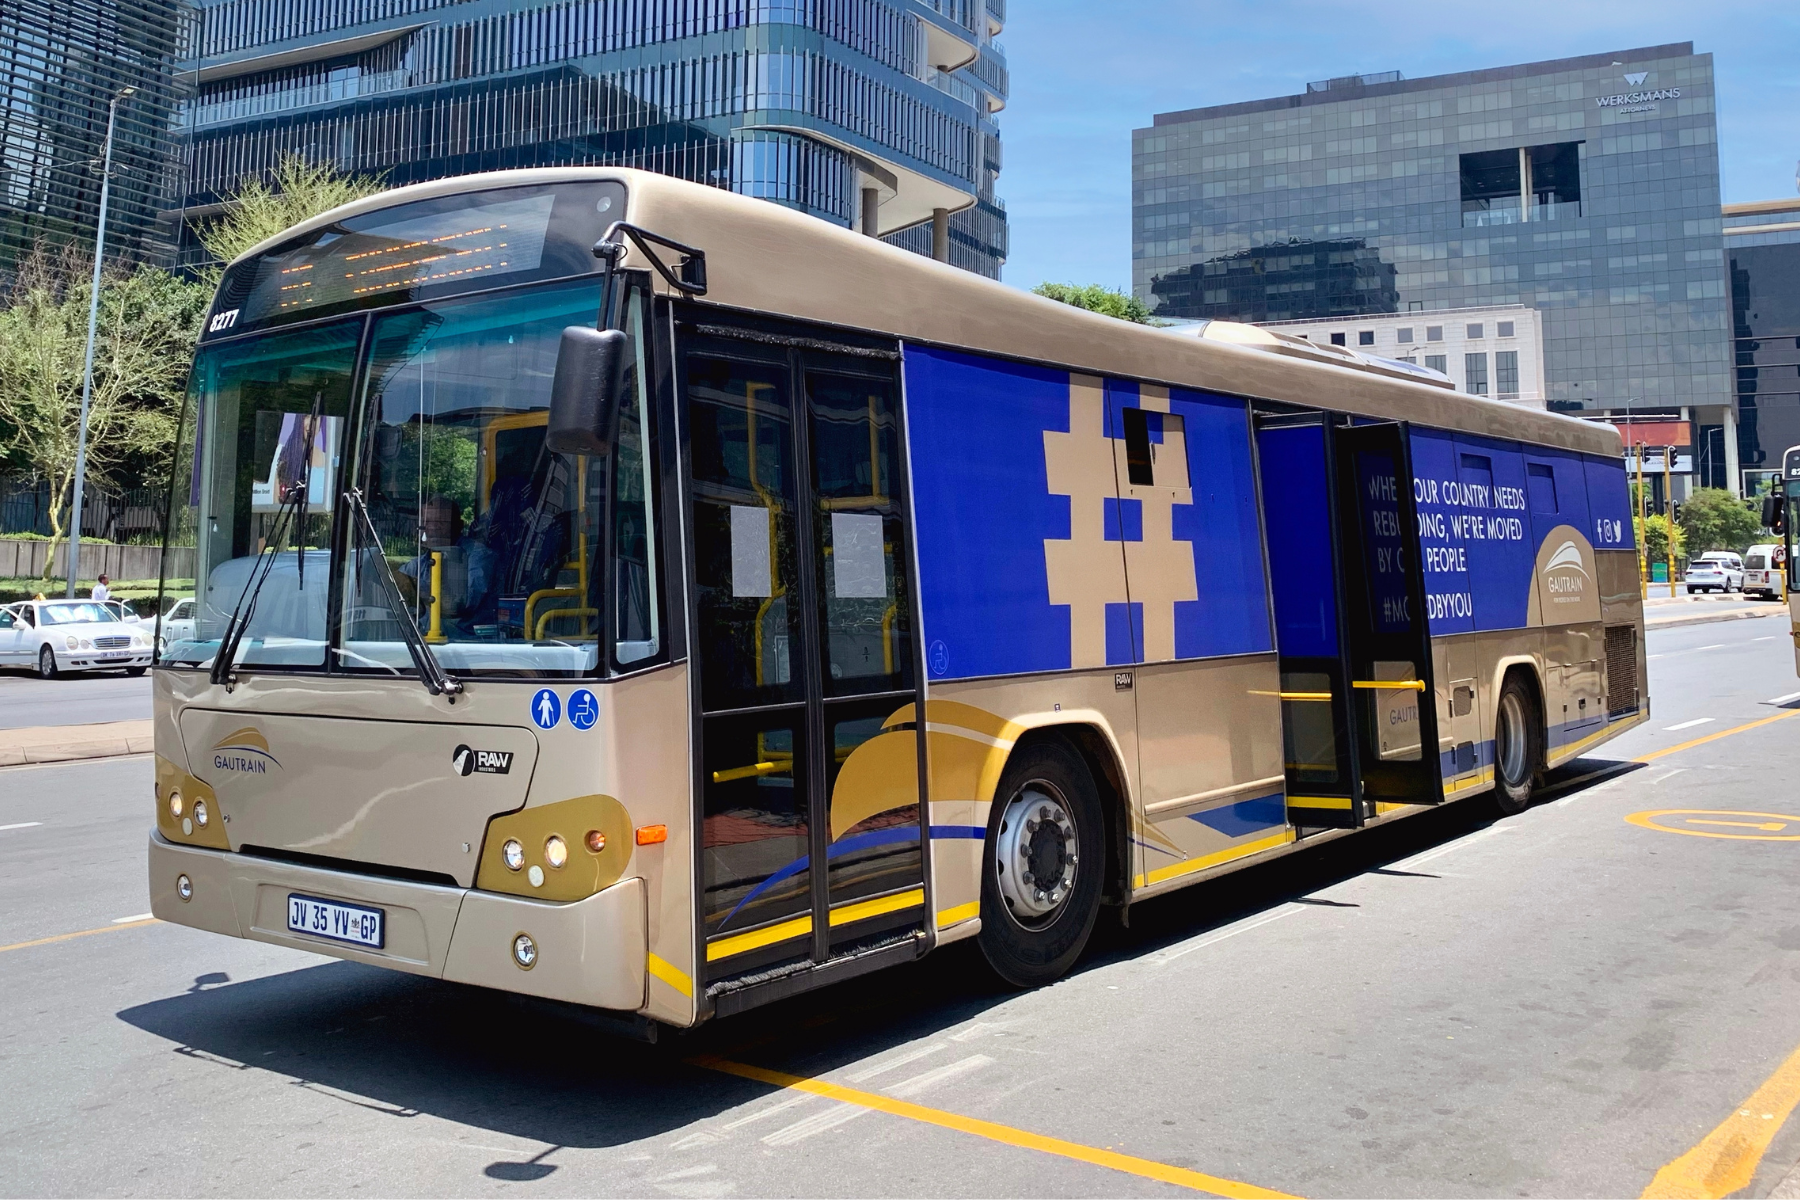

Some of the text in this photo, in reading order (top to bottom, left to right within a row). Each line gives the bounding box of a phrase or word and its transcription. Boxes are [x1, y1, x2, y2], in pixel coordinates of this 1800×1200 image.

[1595, 87, 1681, 107] WERKSMANS
[1620, 104, 1656, 114] ATTORNEYS
[209, 308, 240, 332] 8277
[1368, 474, 1526, 511] WHE OUR COUNTRY NEEDS
[1373, 511, 1523, 543] REBING, WE'RE MOVED
[1377, 547, 1392, 573] BY
[1548, 576, 1583, 593] GAUTRAIN
[1383, 592, 1473, 622] #MODBYYOU
[1115, 673, 1132, 685] RAW
[1389, 705, 1419, 726] GAUTR
[214, 755, 266, 774] GAUTRAIN
[478, 751, 509, 768] RAW
[292, 901, 377, 941] JV 35 YV GP
